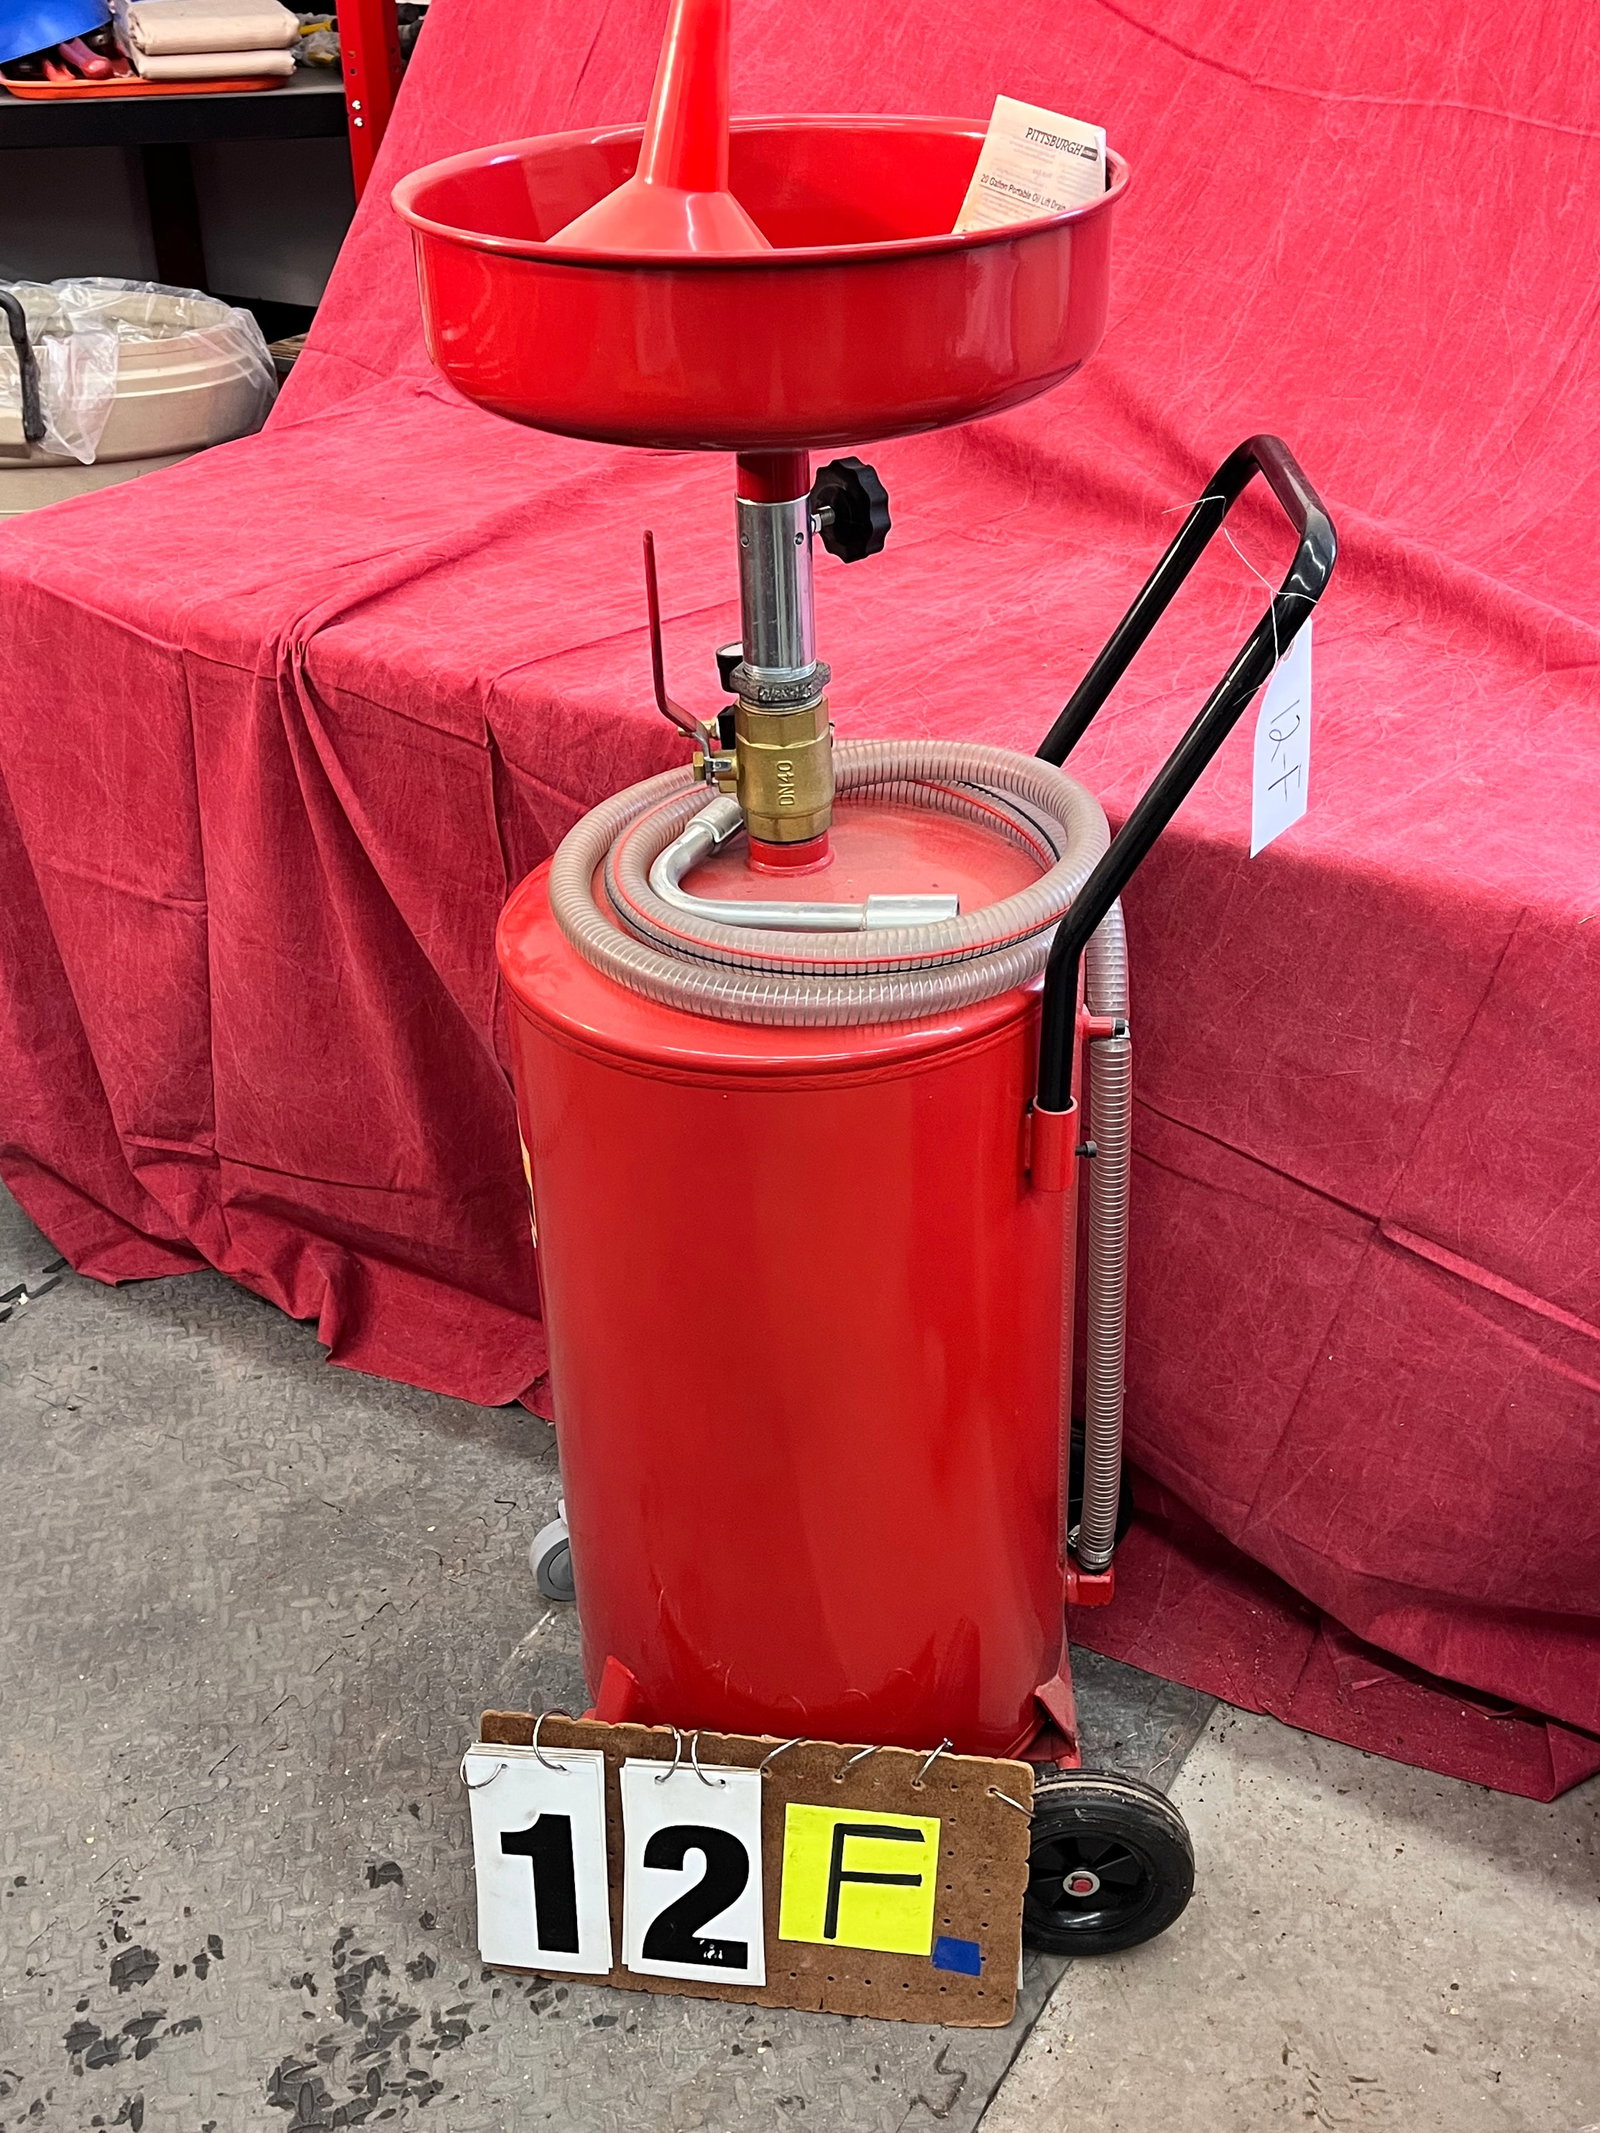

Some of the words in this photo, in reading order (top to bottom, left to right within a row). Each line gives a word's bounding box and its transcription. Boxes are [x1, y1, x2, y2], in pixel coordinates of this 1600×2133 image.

[1025, 127, 1083, 156] PITTSBURGH
[980, 174, 989, 184] 20
[989, 177, 1008, 191] Gallon
[1008, 184, 1031, 200] Portable
[1032, 193, 1041, 203] Oil
[1041, 197, 1051, 208] Lift
[777, 760, 795, 807] DN40
[823, 1822, 925, 1940] F
